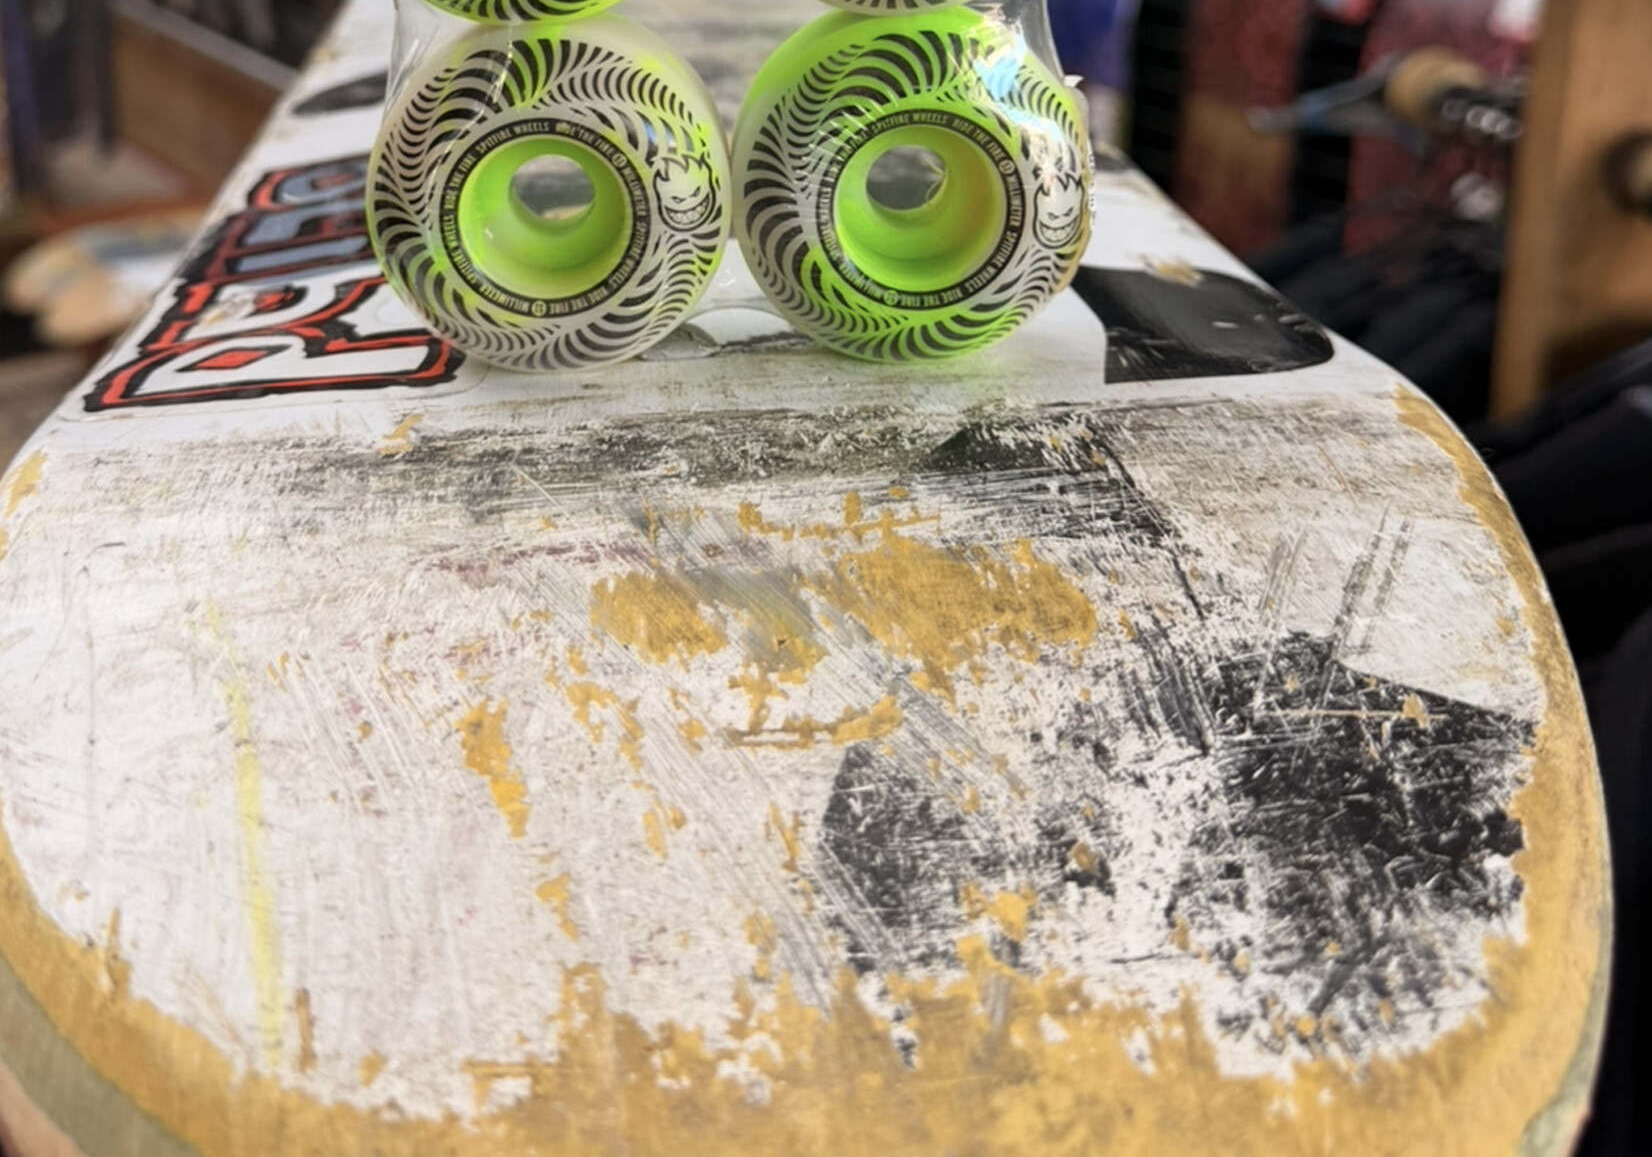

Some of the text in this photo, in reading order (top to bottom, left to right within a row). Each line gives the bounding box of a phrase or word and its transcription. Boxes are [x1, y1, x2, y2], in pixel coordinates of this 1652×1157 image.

[912, 112, 947, 123] WHEELS
[952, 118, 973, 133] RIDE
[512, 122, 547, 134] WHEELS
[578, 128, 594, 143] THE
[972, 129, 989, 144] THE
[475, 128, 511, 153] SPITFIRE
[594, 137, 614, 155] FIRE
[985, 141, 1005, 160] FIRE
[458, 154, 476, 171] FIRE
[449, 172, 464, 188] THE
[622, 166, 645, 214] MILLIMETER
[444, 191, 456, 208] RIDE
[1005, 175, 1021, 227] MILLIMETER
[444, 215, 459, 248] WHEELS
[629, 222, 645, 258] SPITFIRE
[992, 230, 1016, 268] SPITFIRE
[608, 257, 634, 288] WHEELS
[965, 264, 996, 293] WHEELS
[588, 285, 608, 303] RIDE
[924, 294, 939, 305] THE
[941, 287, 962, 302] RIDE
[550, 302, 568, 314] FIRE
[571, 296, 587, 310] THE
